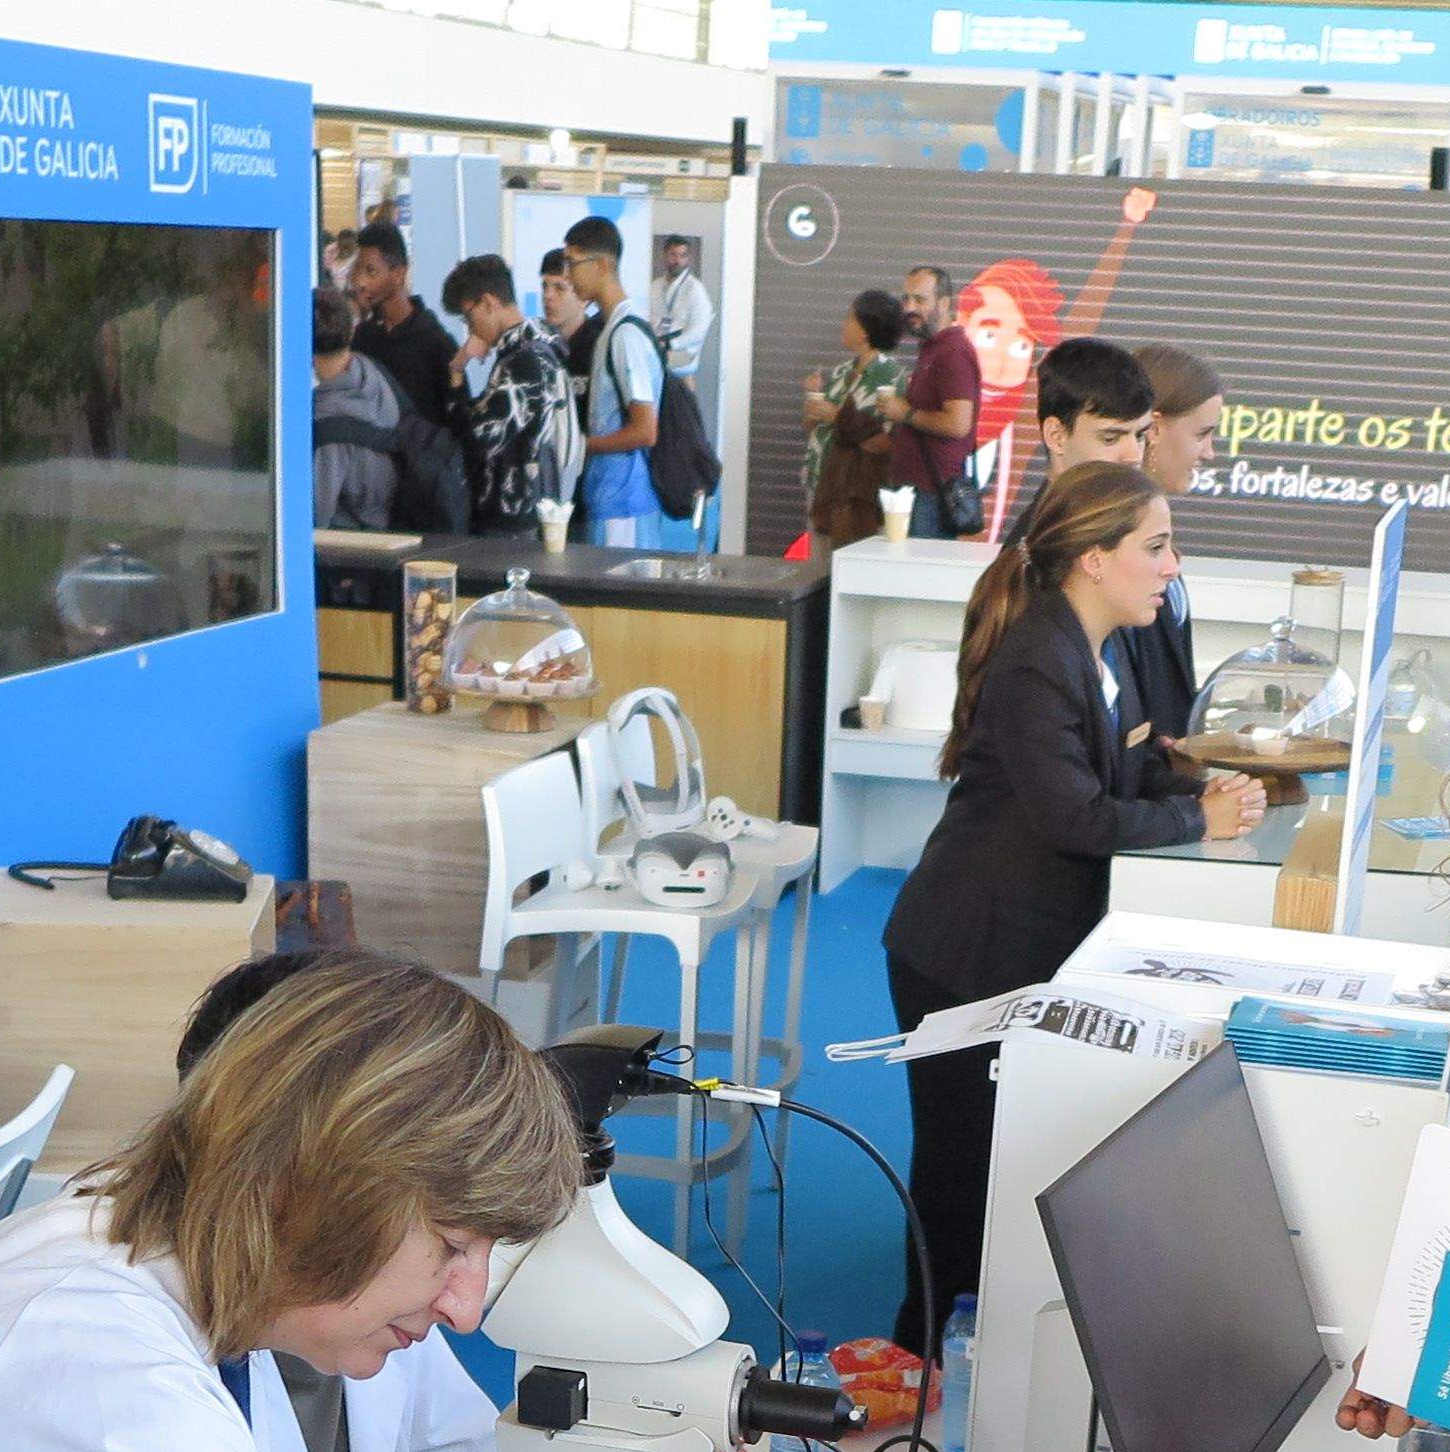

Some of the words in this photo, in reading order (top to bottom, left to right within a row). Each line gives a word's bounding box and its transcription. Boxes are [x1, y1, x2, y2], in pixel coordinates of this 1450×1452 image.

[0, 135, 29, 176] DE
[35, 138, 119, 181] GALICIA
[157, 115, 190, 172] FP
[211, 124, 272, 151] FORMACIÓN
[211, 153, 278, 178] PROFESIONAL
[1219, 399, 1346, 457] parte
[1358, 414, 1412, 450] os
[1230, 460, 1374, 503] fortalezas
[1380, 484, 1401, 503] e
